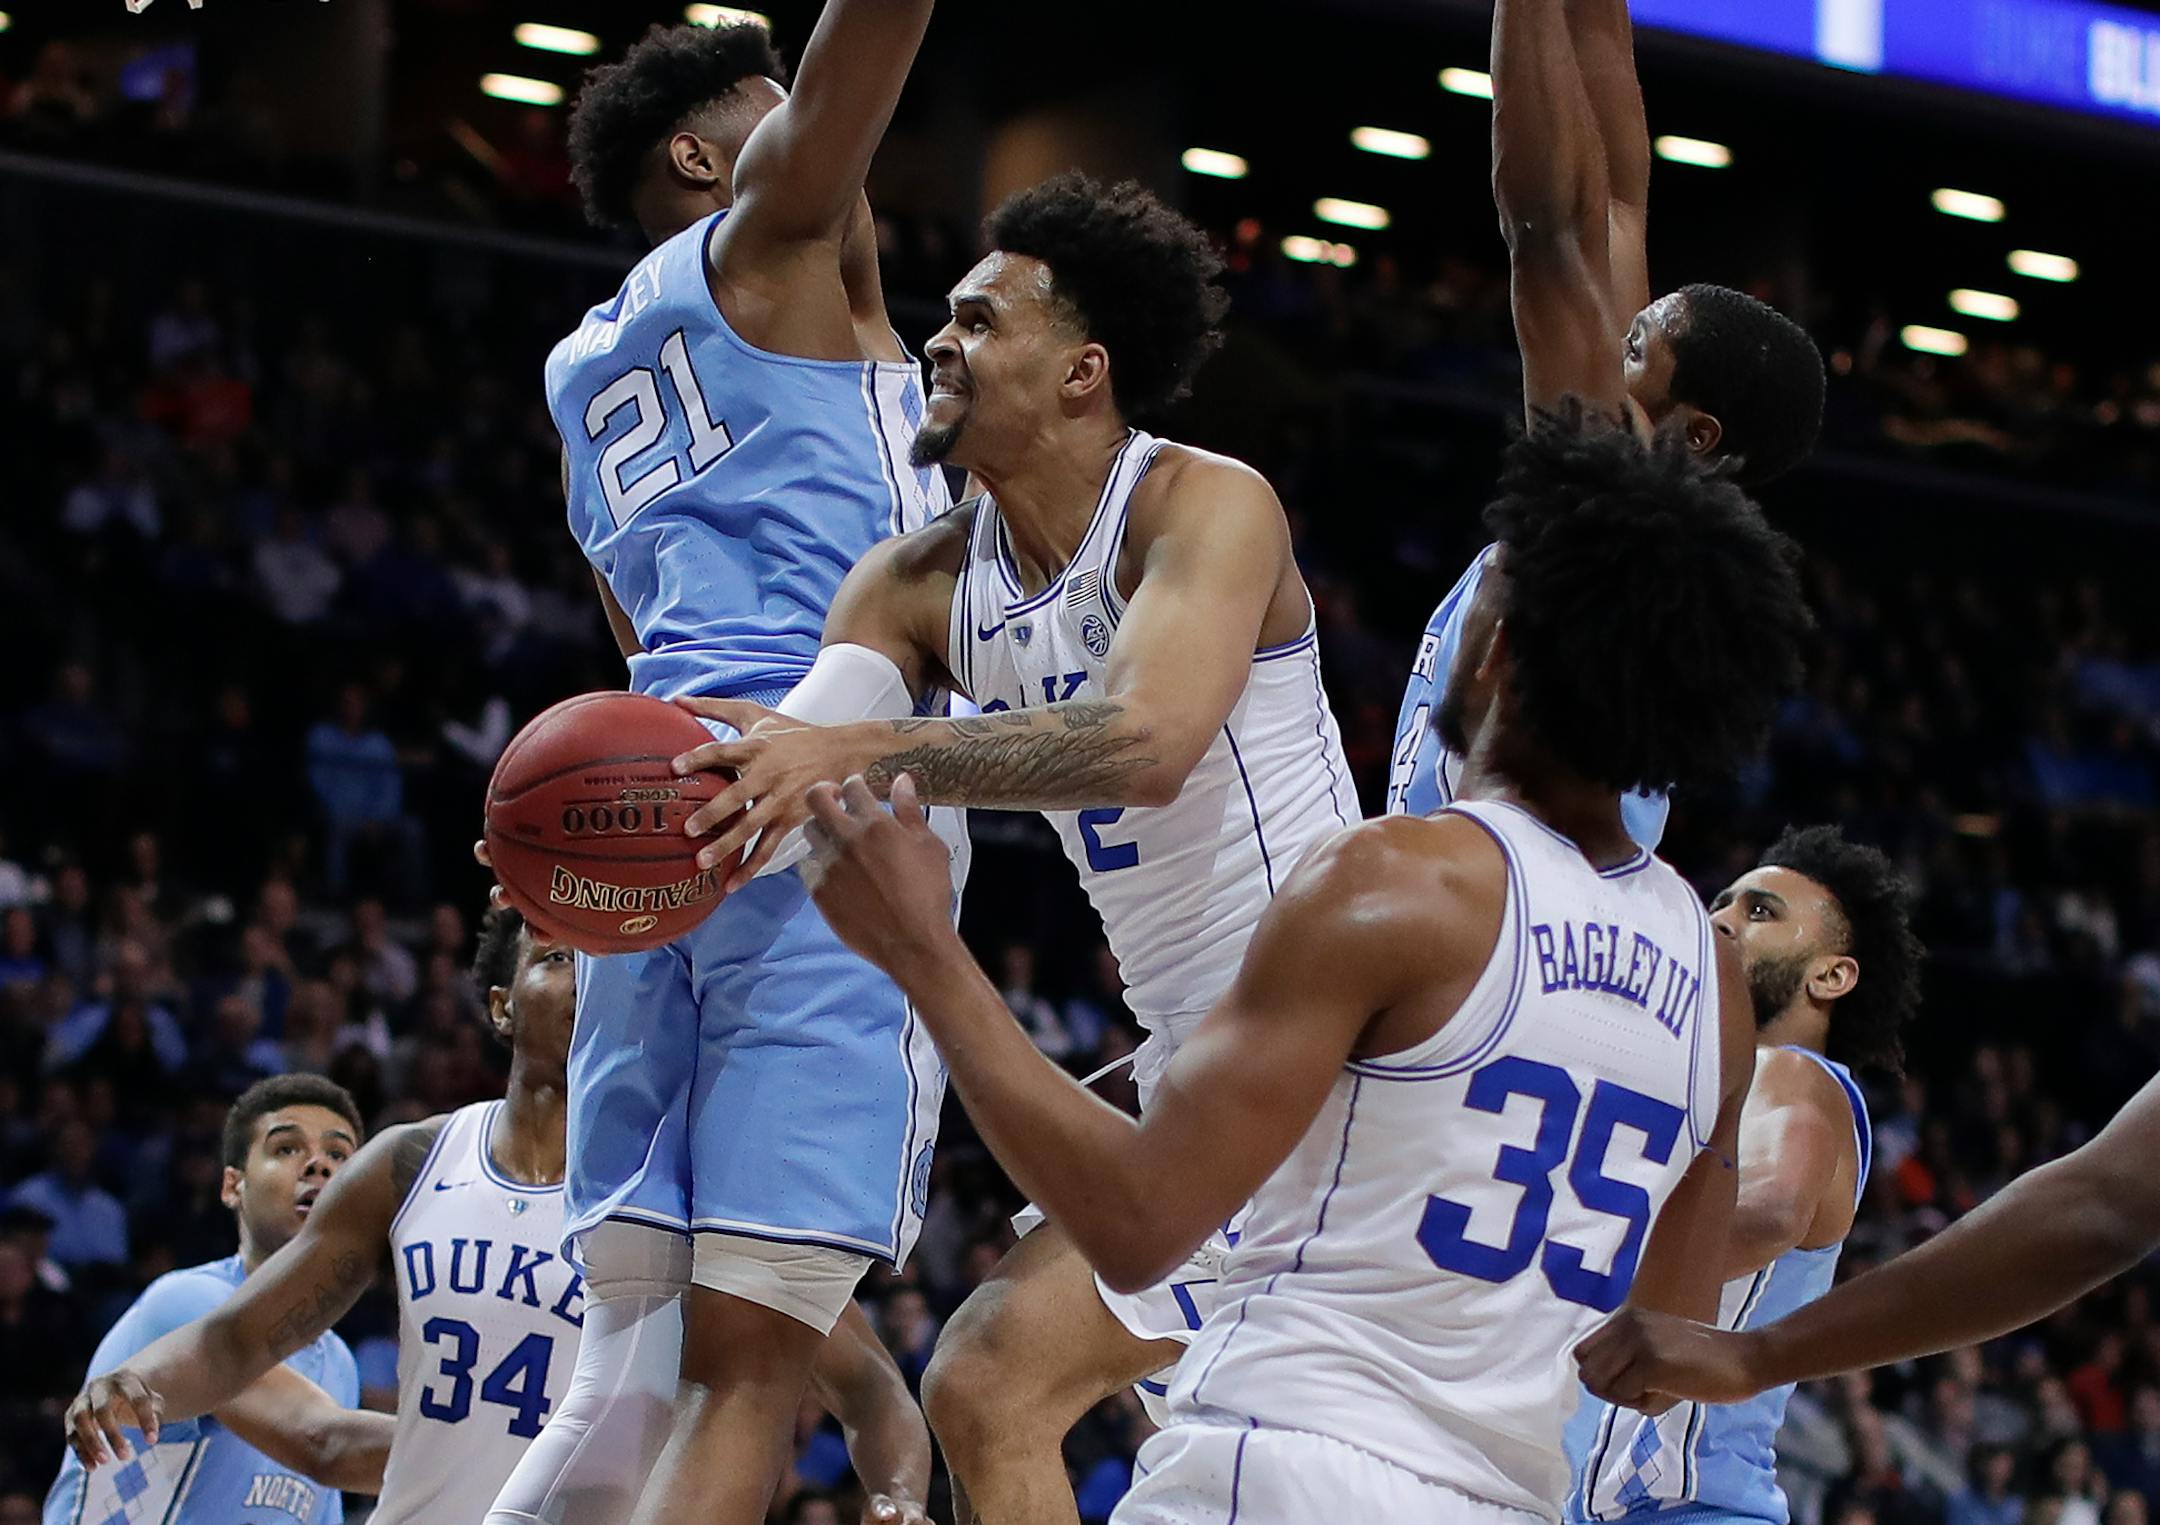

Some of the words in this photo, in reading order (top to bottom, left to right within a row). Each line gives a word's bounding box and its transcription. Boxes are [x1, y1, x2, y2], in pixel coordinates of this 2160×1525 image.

[583, 326, 735, 531] 21
[550, 864, 723, 913] SPALDING
[1530, 919, 1663, 1011] BAGLEY
[1654, 956, 1701, 1041] III
[1415, 1054, 1688, 1315] 35
[419, 1316, 555, 1440] 34
[243, 1474, 315, 1524] NORTH
